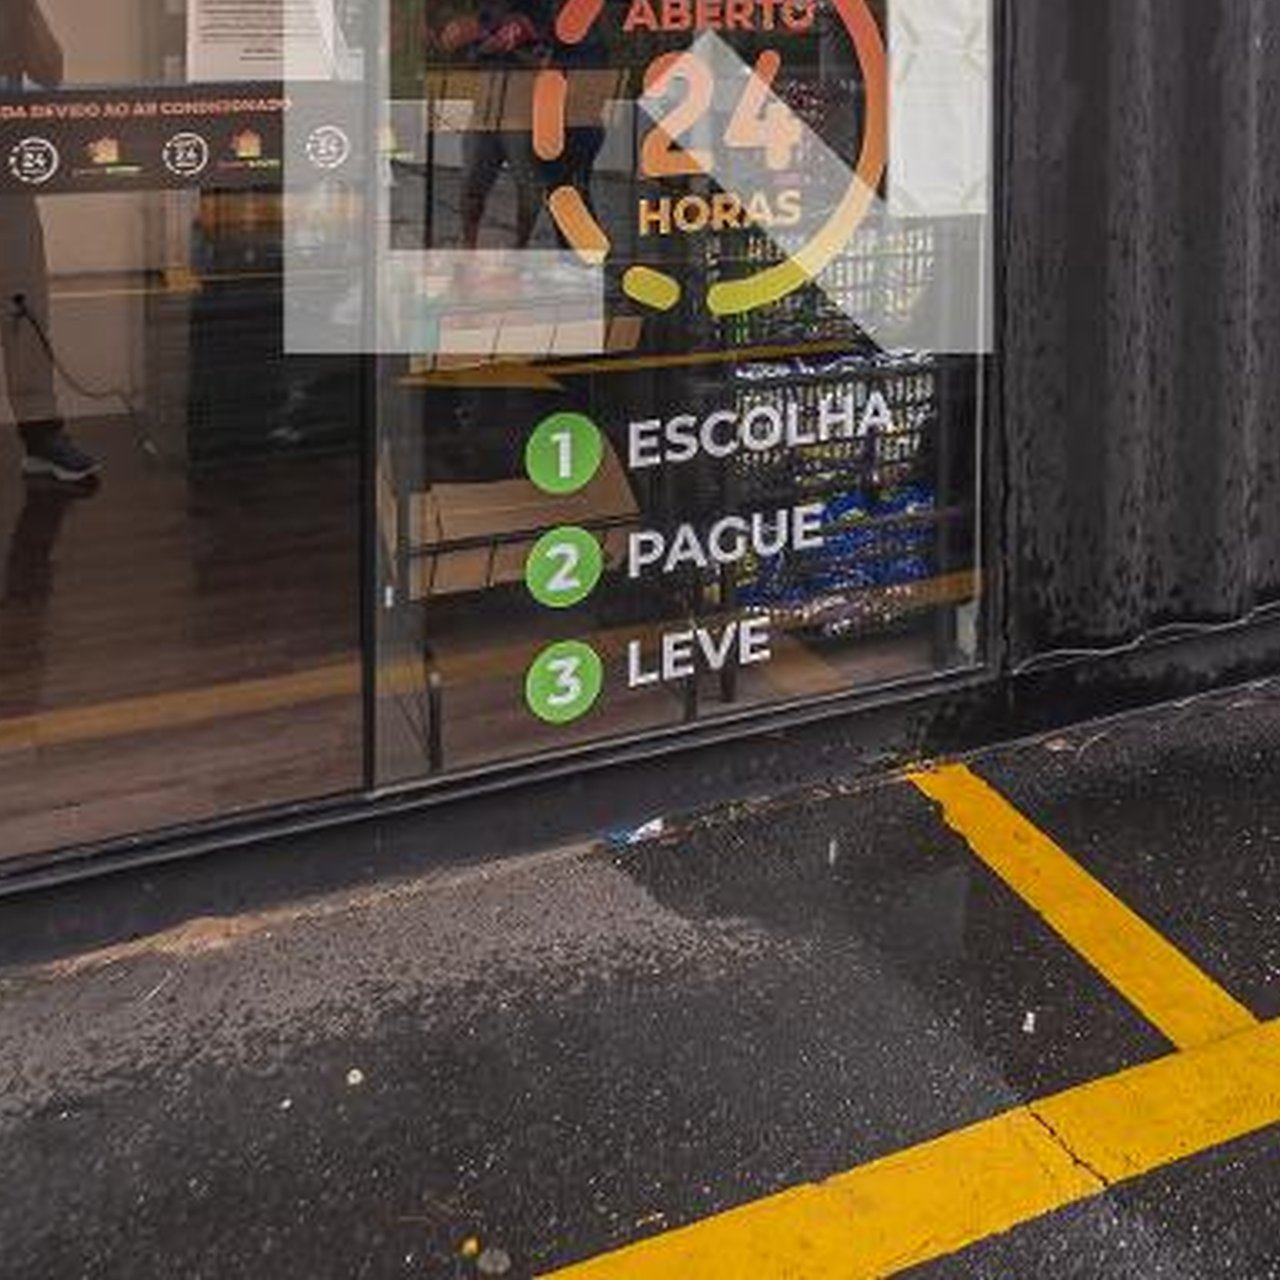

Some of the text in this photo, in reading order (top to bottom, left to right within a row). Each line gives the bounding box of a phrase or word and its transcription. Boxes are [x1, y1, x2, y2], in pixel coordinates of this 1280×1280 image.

[639, 50, 805, 179] 24
[639, 189, 802, 236] HORAS
[550, 389, 895, 479] 1 ESCOLHA
[547, 503, 826, 591] 2 PAGUE
[547, 617, 771, 705] 3 LEVE
